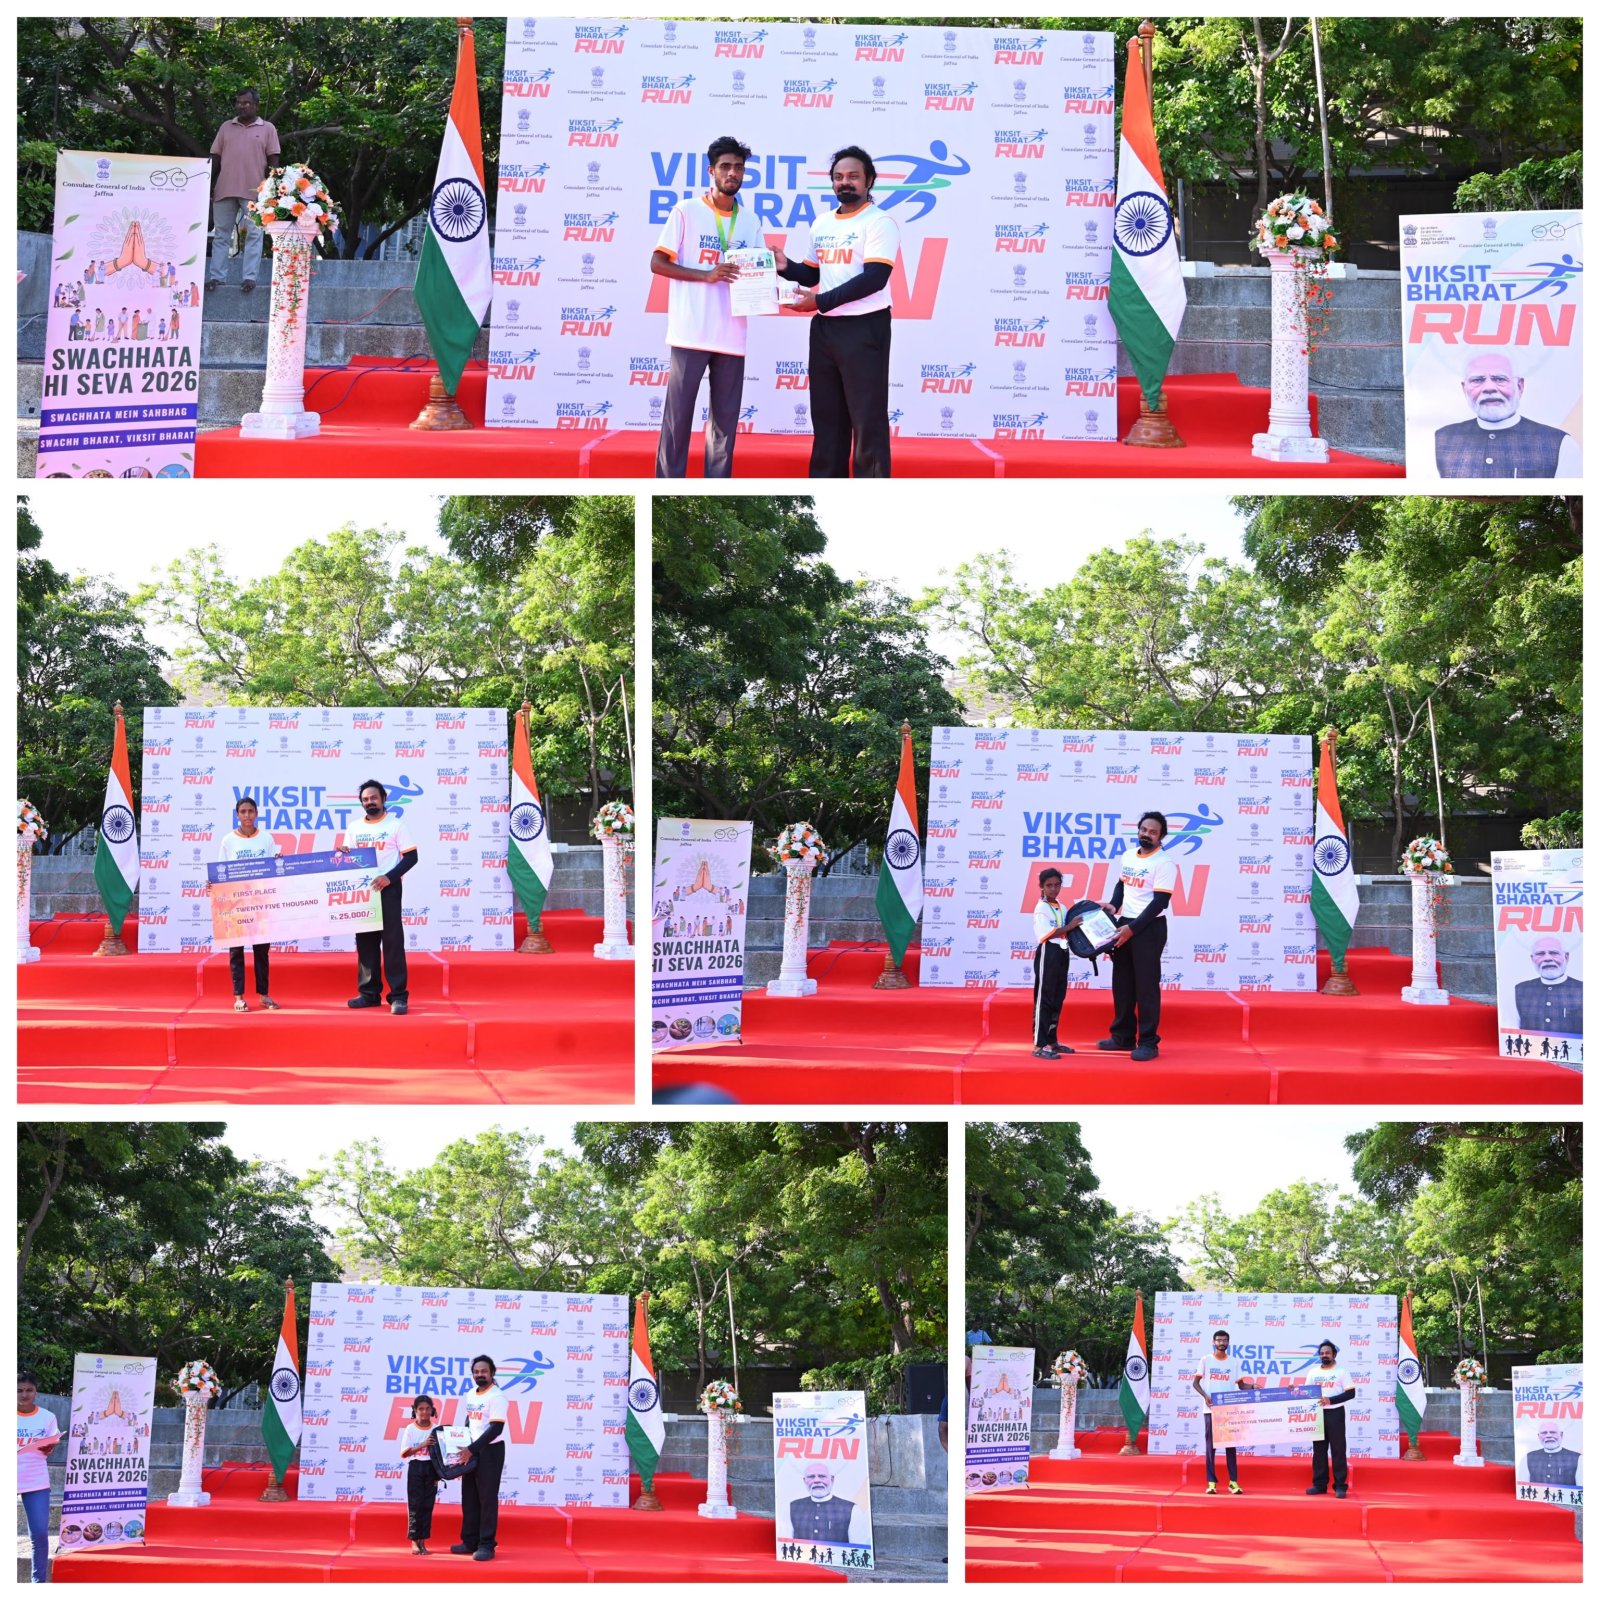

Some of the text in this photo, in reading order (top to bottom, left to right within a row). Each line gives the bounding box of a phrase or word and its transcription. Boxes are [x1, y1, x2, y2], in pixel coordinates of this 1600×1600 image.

[575, 39, 624, 54] RUN
[715, 44, 764, 58] RUN
[855, 48, 904, 62] RUN
[994, 51, 1043, 64] RUN
[641, 89, 691, 104] RUN
[784, 93, 832, 108] RUN
[925, 96, 974, 111] RUN
[1065, 99, 1114, 115] RUN
[568, 133, 618, 147] RUN
[995, 144, 1044, 159] RUN
[63, 181, 94, 189] Consulate
[563, 227, 615, 242] RUN
[995, 238, 1046, 253] RUN
[816, 249, 852, 264] RUN
[1407, 265, 1491, 282] VIKSIT
[1407, 284, 1516, 301] BHARAT
[561, 321, 612, 337] RUN
[1409, 304, 1576, 346] RUN
[994, 332, 1046, 348] RUN
[52, 346, 192, 370] SWACHHATA
[44, 370, 197, 397] HI SEVA 2026
[921, 378, 972, 394] RUN
[50, 407, 187, 423] SWACHHATA MEIN SAHBHAG
[40, 431, 194, 448] SWACHH BHARAT, VIKSIT BHARAT
[186, 720, 214, 728] RUN
[976, 740, 1006, 750] RUN
[232, 786, 326, 807] VIKSIT
[232, 809, 352, 830] HARAT
[1023, 812, 1121, 835] VIKSIT
[326, 879, 348, 888] VIKSIT
[326, 885, 355, 893] BHARAT
[1496, 882, 1548, 893] VIKSIT
[233, 888, 276, 898] FIRST PLACE
[328, 889, 370, 906] RUN
[1496, 894, 1563, 905] BHARAT
[236, 904, 264, 913] TWENTY
[282, 899, 318, 908] THOUSAND
[653, 940, 739, 956] SWACHHATA
[668, 956, 703, 971] SEVA
[708, 955, 742, 969] 2026
[1194, 954, 1226, 962] RUN
[348, 1296, 372, 1304] RUN
[388, 1355, 469, 1376] VIKSIT
[386, 1375, 473, 1396] BHARA
[1288, 1413, 1316, 1423] RUN
[1516, 1402, 1583, 1419] RUN
[776, 1418, 818, 1427] VIKSIT
[971, 1422, 1028, 1433] SWACHHATA
[776, 1428, 830, 1437] BHARAT
[968, 1432, 1030, 1443] HI SEVA 2026
[777, 1438, 860, 1460] RUN
[70, 1457, 145, 1471] SWACHHATA
[66, 1470, 148, 1485] HI SEVA 2026
